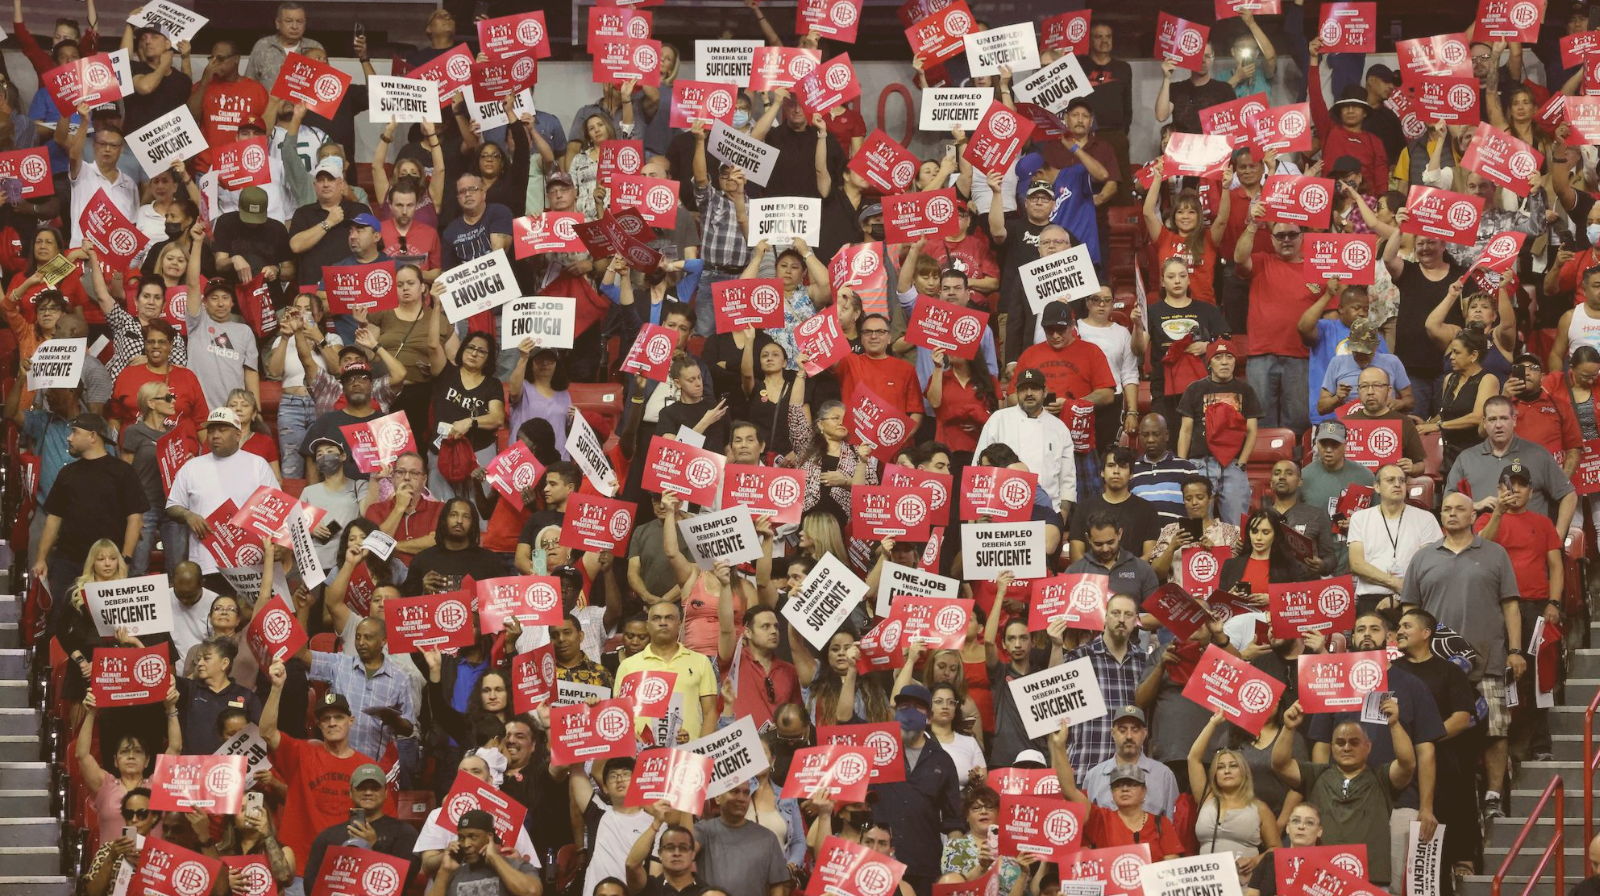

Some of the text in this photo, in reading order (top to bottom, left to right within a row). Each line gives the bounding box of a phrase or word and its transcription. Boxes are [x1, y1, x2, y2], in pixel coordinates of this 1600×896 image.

[170, 7, 195, 22] EMPLEO
[976, 30, 1023, 45] UN EMPLEO
[979, 46, 1026, 67] SUFICIENTE
[706, 63, 751, 76] SUFICIENTE
[1025, 74, 1047, 91] ONE
[1048, 62, 1068, 78] JOB
[396, 83, 426, 92] EMPLEO
[1032, 74, 1078, 108] ENOUGH
[381, 97, 427, 113] SUFICIENTE
[932, 108, 979, 120] SUFICIENTE
[138, 116, 182, 142] UN EMPLEO
[171, 126, 182, 135] SER
[147, 130, 193, 164] SUFICIENTE
[722, 130, 767, 157] UN EMPLEO
[716, 142, 760, 175] SUFICIENTE
[747, 151, 759, 160] SER
[1412, 209, 1430, 217] WORKERS
[1419, 206, 1437, 214] CULINARY
[759, 220, 807, 234] SUFICIENTE
[446, 258, 497, 283] ONE JOB
[1030, 254, 1078, 276] UN EMPLEO
[1063, 265, 1075, 273] SER
[452, 274, 505, 308] ENOUGH
[1035, 271, 1085, 298] SUFICIENTE
[513, 302, 564, 311] ONE JOB
[512, 317, 561, 336] ENOUGH
[207, 344, 239, 360] adidas
[33, 363, 72, 378] SUFICIENTE
[576, 437, 609, 480] SUFICIENTE
[689, 515, 738, 534] UN EMPLEO
[721, 527, 734, 535] SER
[976, 530, 1032, 539] UN EMPLEO
[298, 517, 316, 571] UN EMPLEO
[693, 534, 746, 559] SUFICIENTE
[976, 549, 1031, 567] SUFICIENTE
[792, 567, 831, 612] UN EMPLEO
[822, 578, 834, 591] SER
[894, 571, 946, 592] ONE JOB
[98, 584, 155, 598] UN EMPLEO
[100, 604, 157, 624] SUFICIENTE
[806, 580, 852, 631] SUFICIENTE
[1023, 668, 1080, 694] UN EMPLEO
[1062, 682, 1076, 692] SER
[1202, 673, 1234, 694] WORKERS UNION
[1210, 671, 1230, 686] CULINARY
[1029, 690, 1088, 721] SUFICIENTE
[224, 733, 250, 756] JOB
[706, 729, 743, 753] EMPLEO
[728, 742, 741, 753] SER
[309, 772, 350, 790] BARTEND
[1005, 824, 1024, 833] WORKERS
[1012, 820, 1032, 828] CULINARY
[1432, 838, 1438, 856] UN
[1178, 863, 1220, 875] EMPLEO
[1415, 838, 1428, 895] SUFICIENTE
